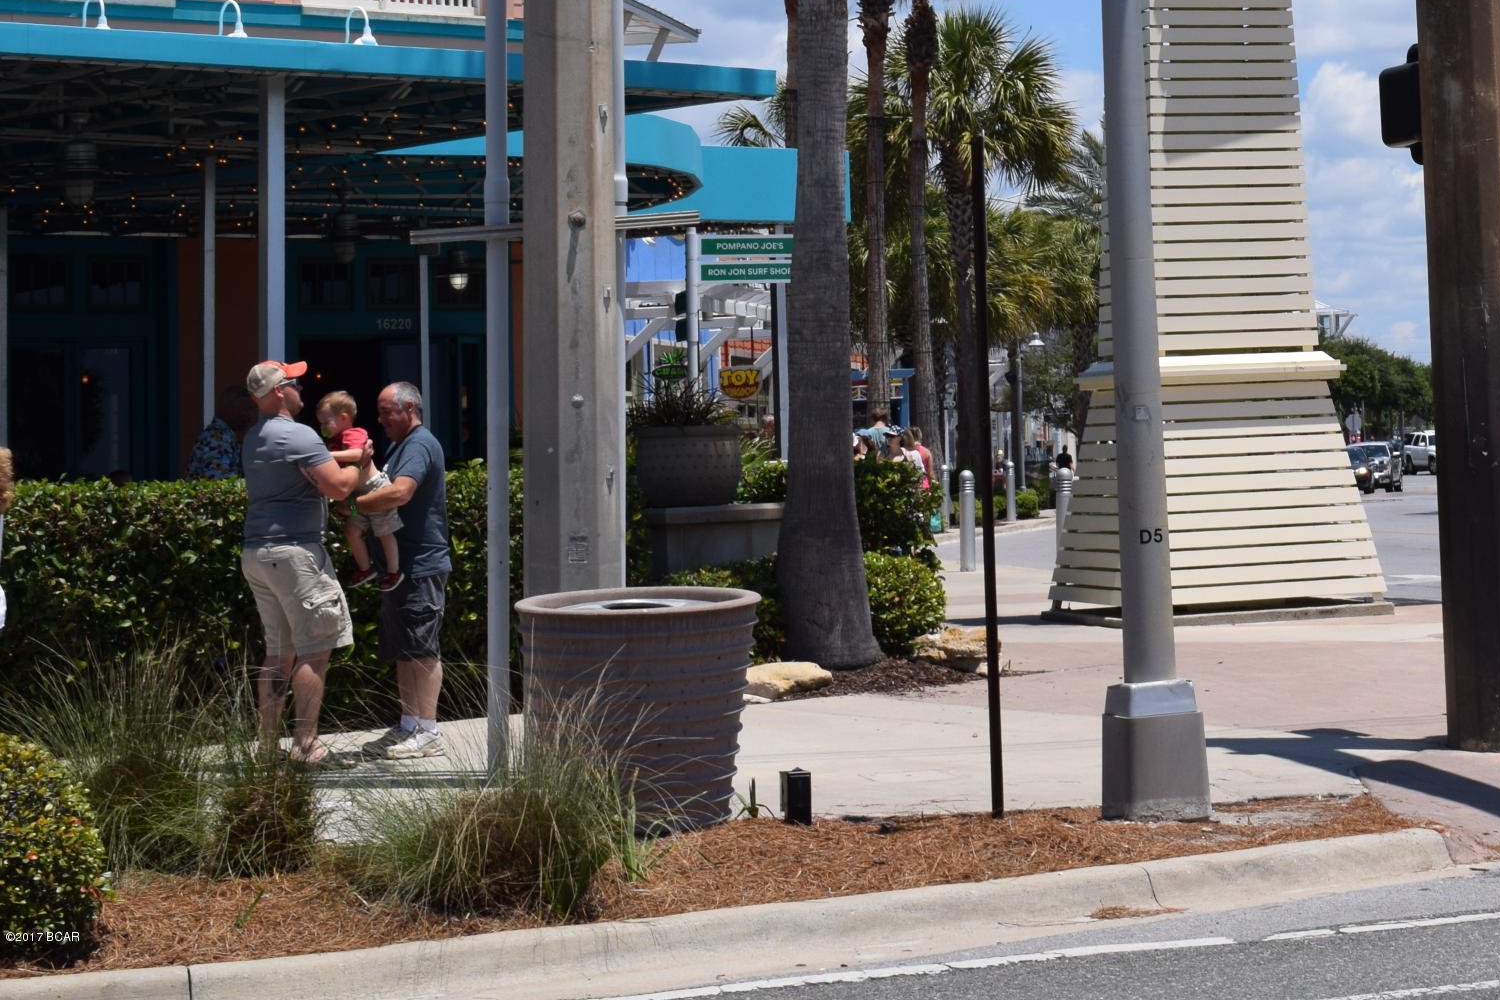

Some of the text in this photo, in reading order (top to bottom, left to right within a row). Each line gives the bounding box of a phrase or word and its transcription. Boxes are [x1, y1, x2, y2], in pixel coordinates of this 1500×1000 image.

[716, 242, 784, 250] POMPANO JOE'S
[707, 268, 726, 276] RON
[727, 268, 746, 276] JON
[747, 267, 768, 276] SURF
[376, 318, 412, 330] 16220
[720, 370, 760, 386] TOY
[1139, 528, 1163, 545] D5
